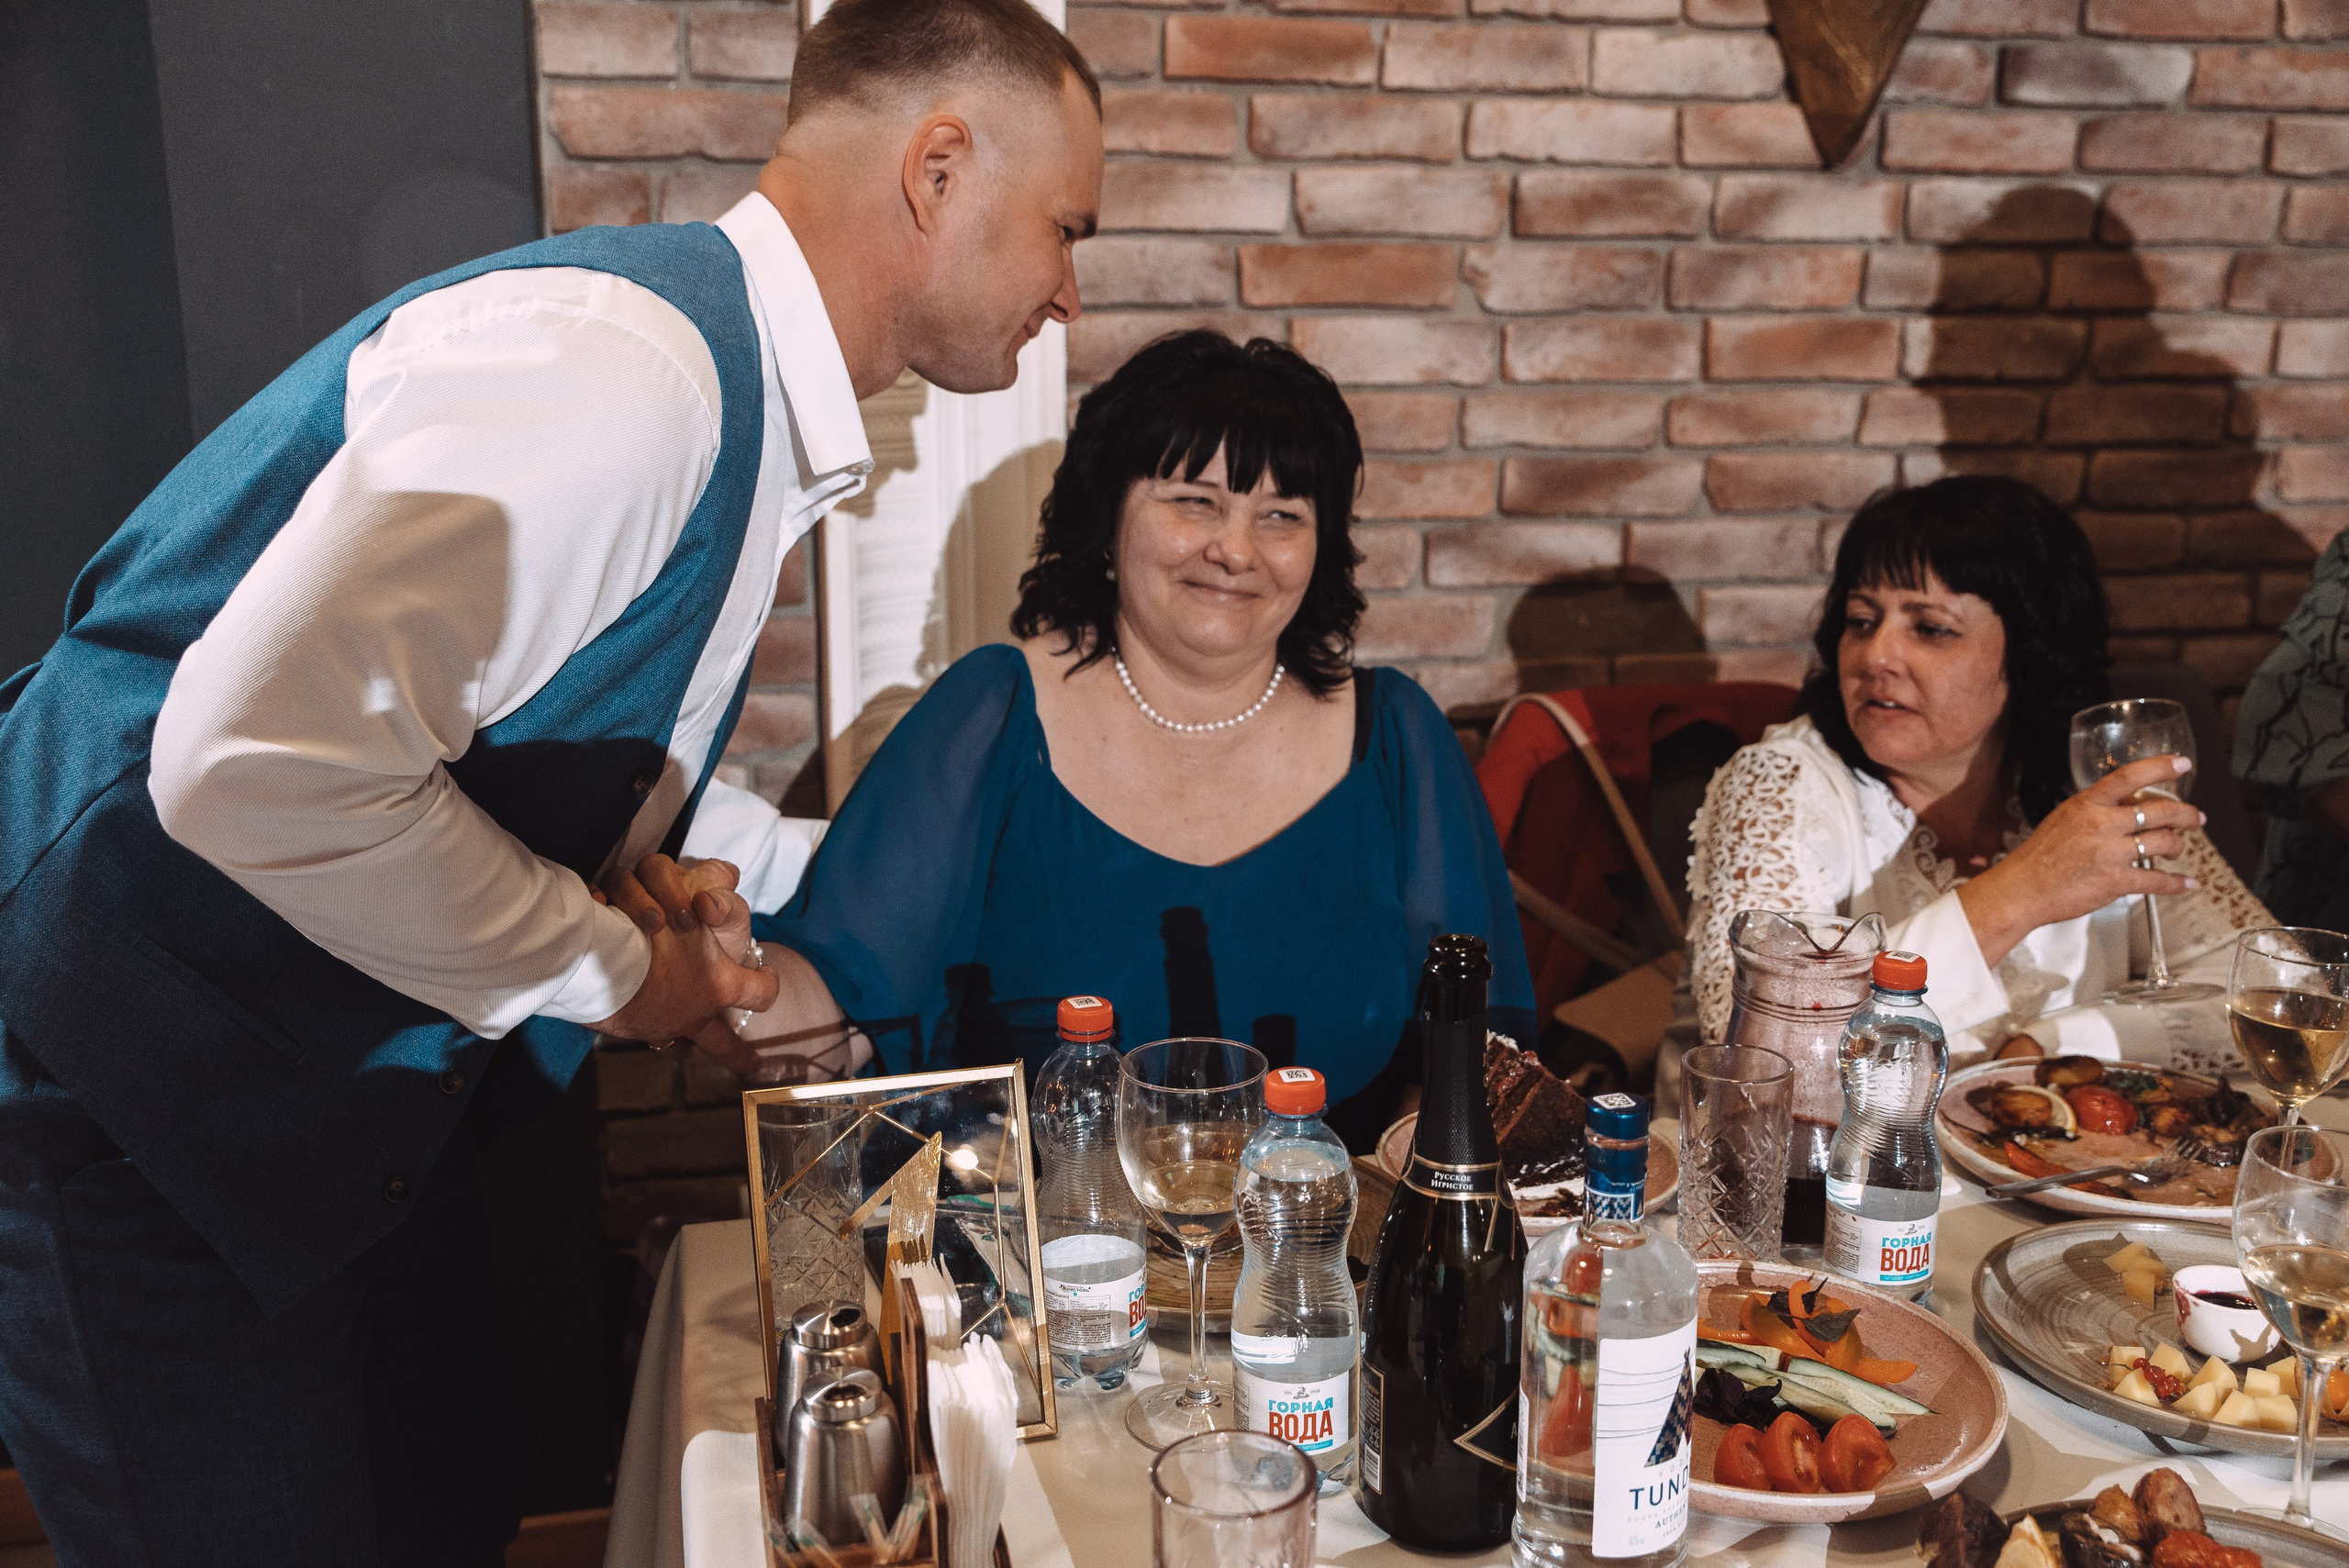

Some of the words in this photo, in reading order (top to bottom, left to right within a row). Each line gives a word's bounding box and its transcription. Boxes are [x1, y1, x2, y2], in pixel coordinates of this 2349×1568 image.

[1882, 1231, 1932, 1248] ГОРНАЯ
[1880, 1243, 1929, 1273] ВОДА
[1129, 1282, 1147, 1303] ГОР
[1268, 1396, 1333, 1413] ГОРНАЯ
[1268, 1409, 1333, 1443] ВОДА
